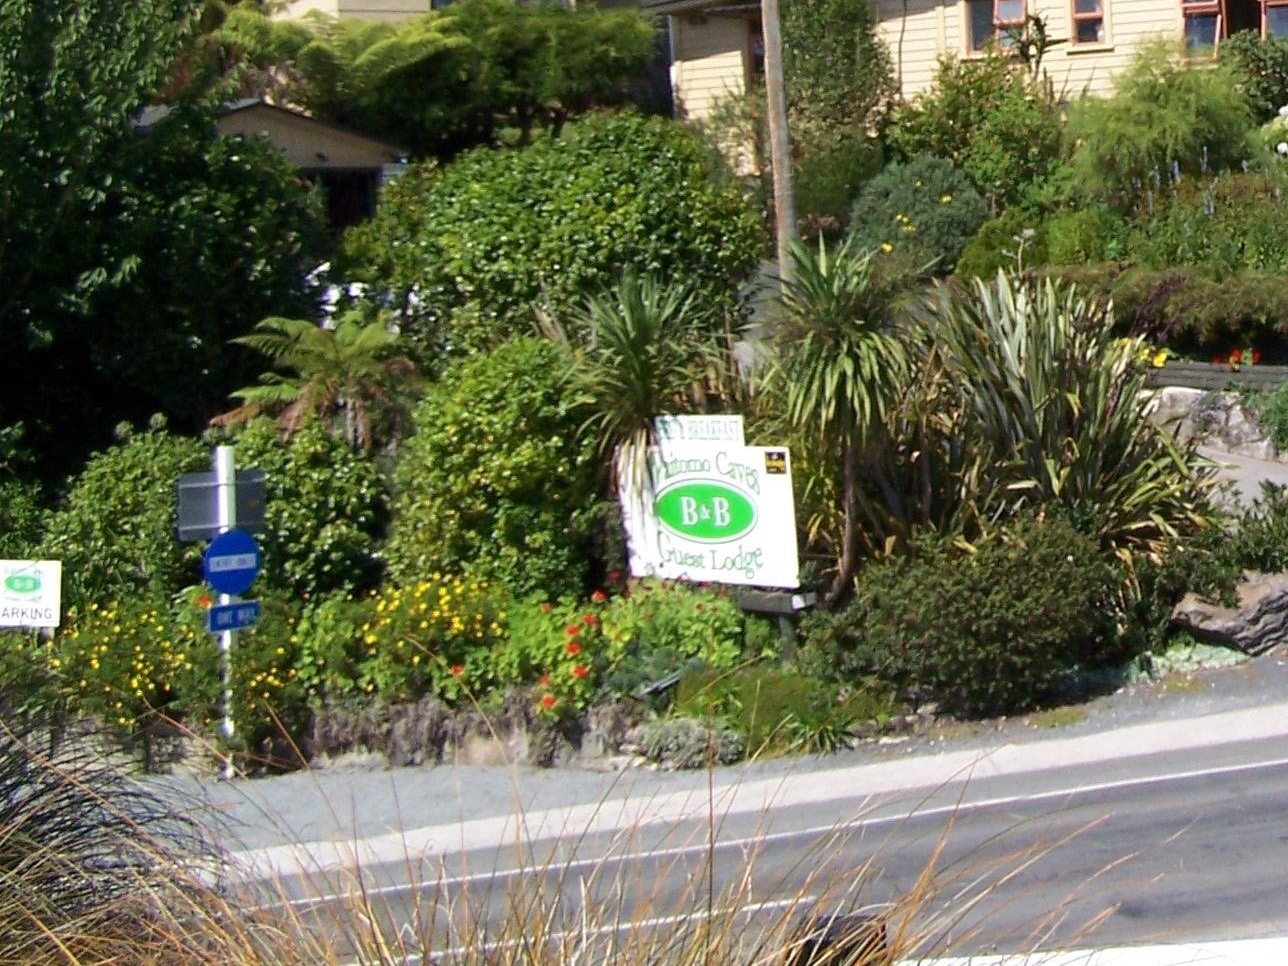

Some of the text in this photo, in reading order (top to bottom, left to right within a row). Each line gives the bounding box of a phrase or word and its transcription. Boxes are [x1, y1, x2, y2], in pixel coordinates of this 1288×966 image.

[715, 451, 761, 495] Caves
[679, 496, 731, 527] B&B
[656, 530, 763, 580] Guest Lodge
